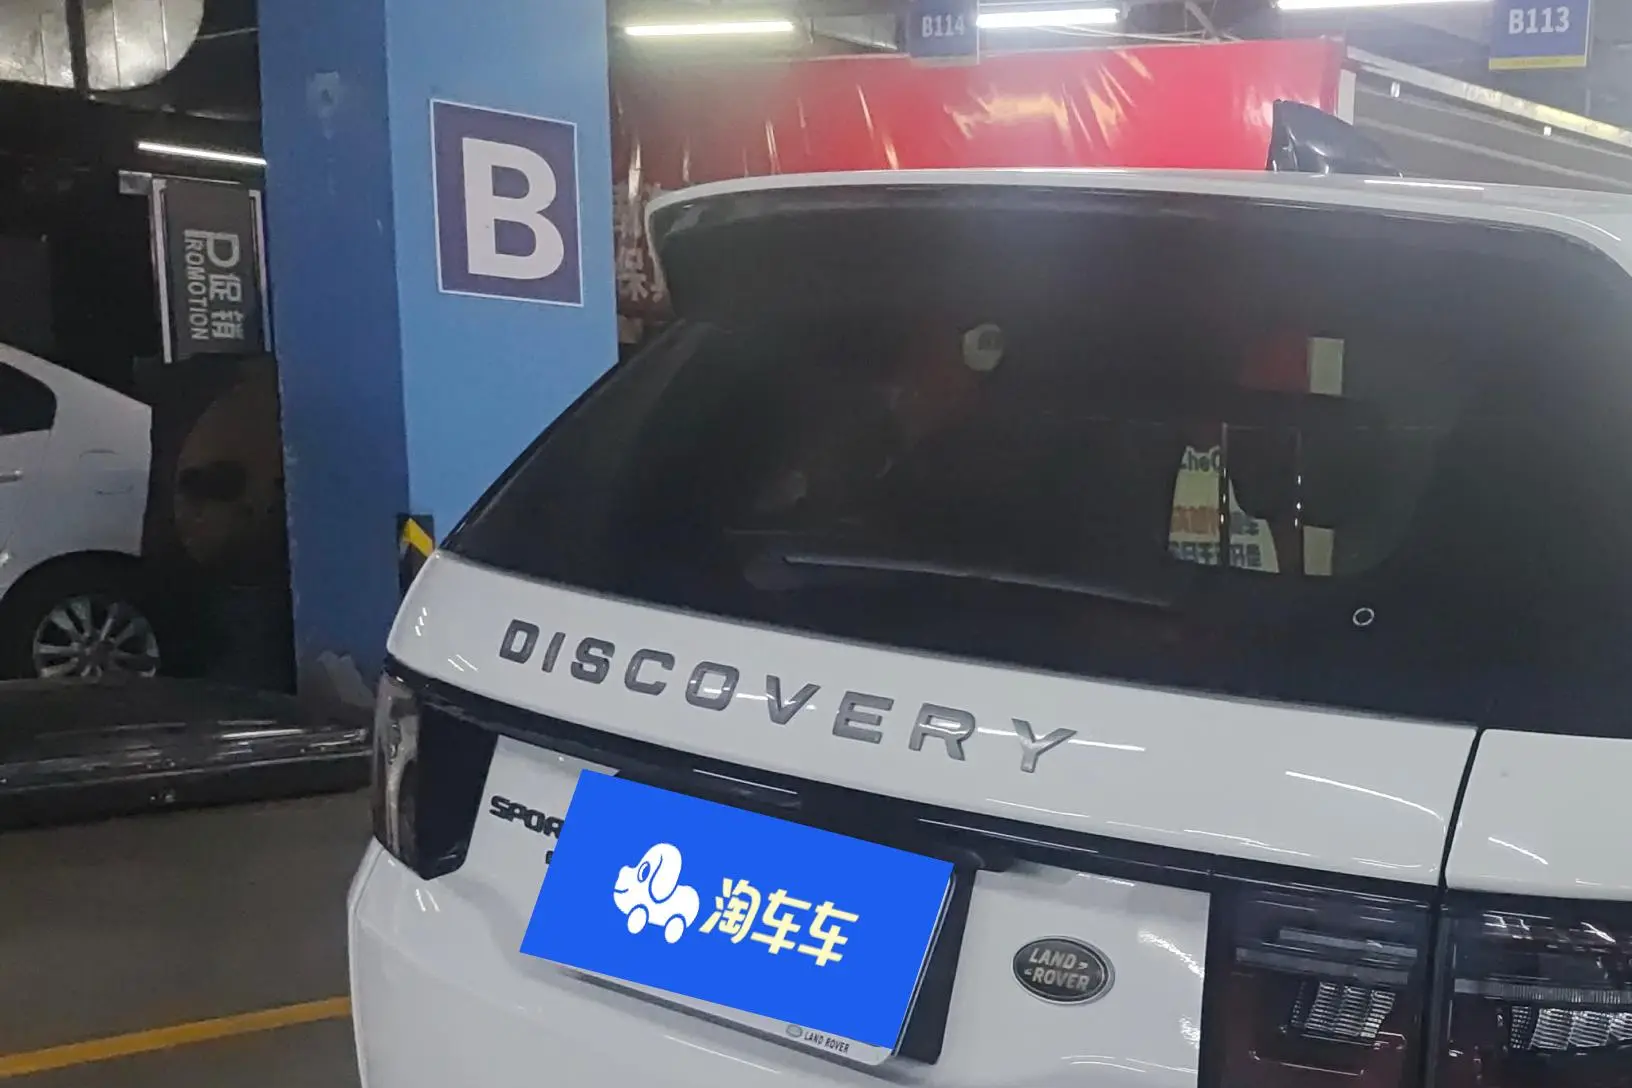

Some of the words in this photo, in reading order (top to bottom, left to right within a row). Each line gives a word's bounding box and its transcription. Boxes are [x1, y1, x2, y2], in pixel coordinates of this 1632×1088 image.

[922, 13, 965, 38] B114
[1508, 6, 1570, 34] B113
[462, 137, 565, 280] B
[499, 619, 1077, 773] DISCOVERY
[489, 795, 565, 839] SPOR
[1028, 947, 1077, 970] LAND
[1031, 966, 1090, 991] ROVER
[804, 1030, 825, 1046] LAND
[824, 1037, 850, 1054] ROVER
